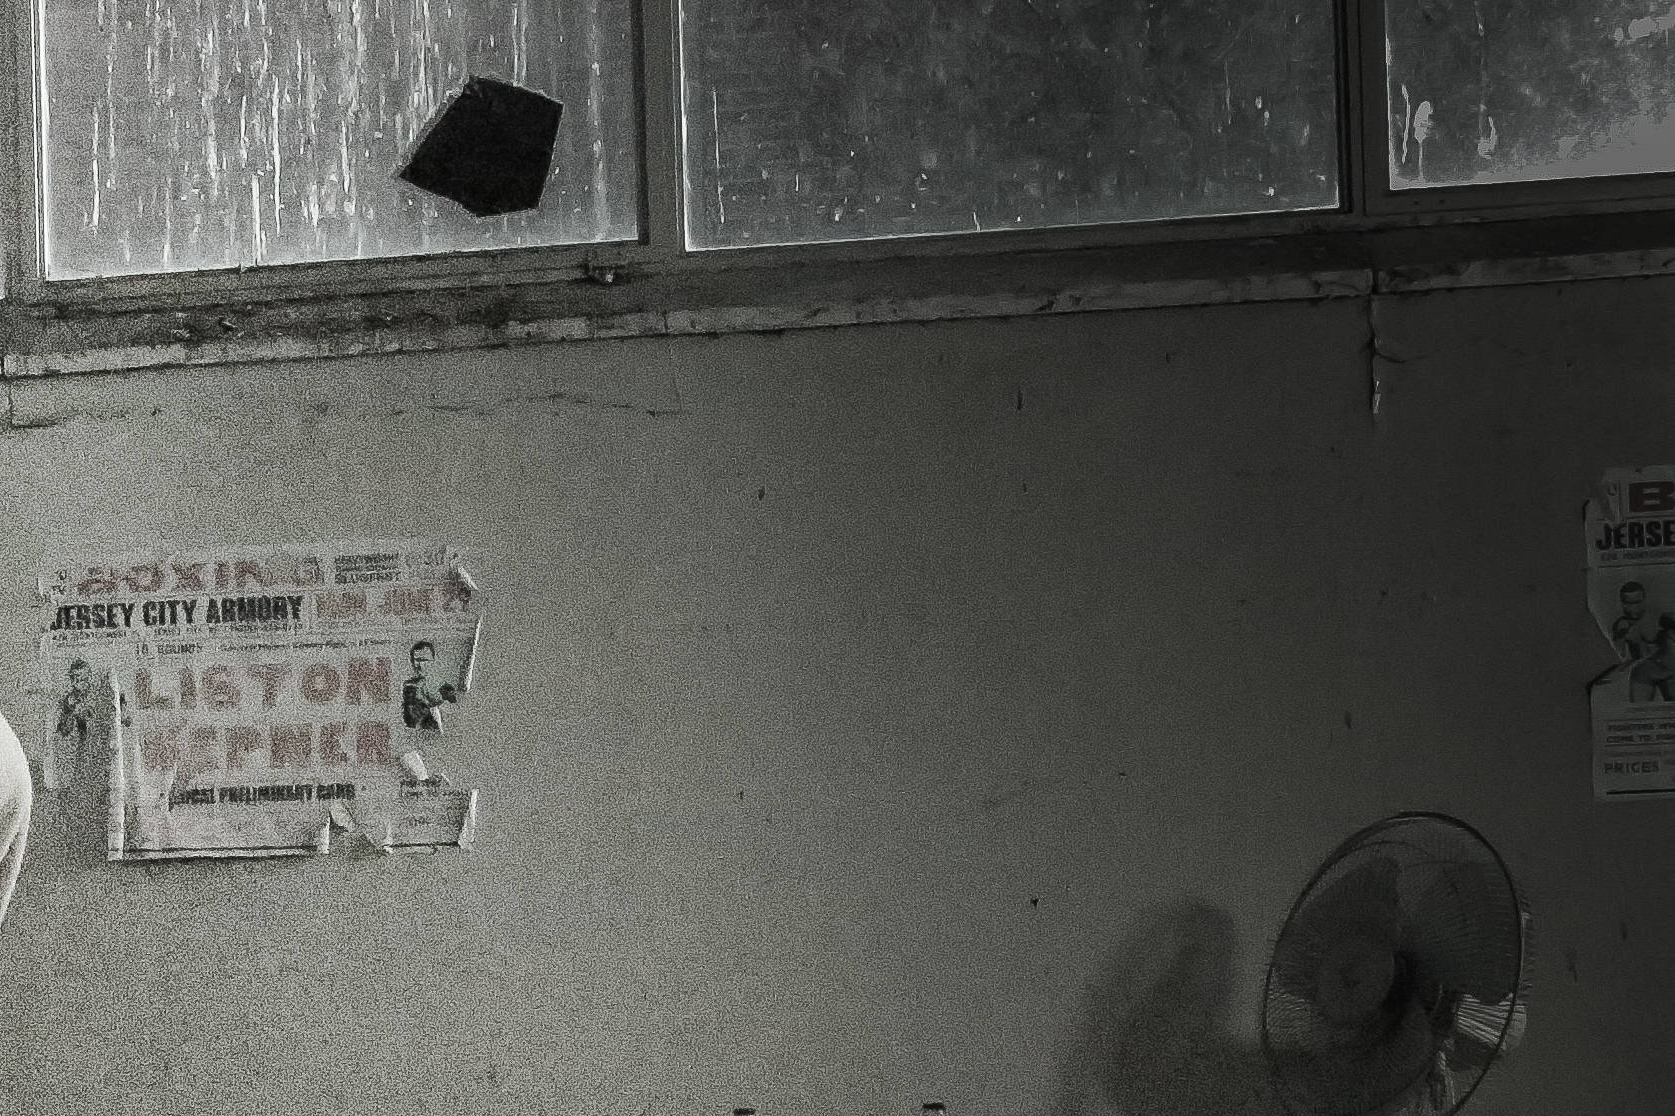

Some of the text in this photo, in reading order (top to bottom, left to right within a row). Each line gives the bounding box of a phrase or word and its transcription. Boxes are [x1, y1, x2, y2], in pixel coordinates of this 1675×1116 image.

[1596, 520, 1675, 550] JERSE
[50, 601, 133, 632] JERSEY
[142, 598, 197, 629] CITY
[206, 596, 303, 625] ARMORY
[134, 657, 393, 711] LISTON
[1604, 761, 1659, 774] PRICES
